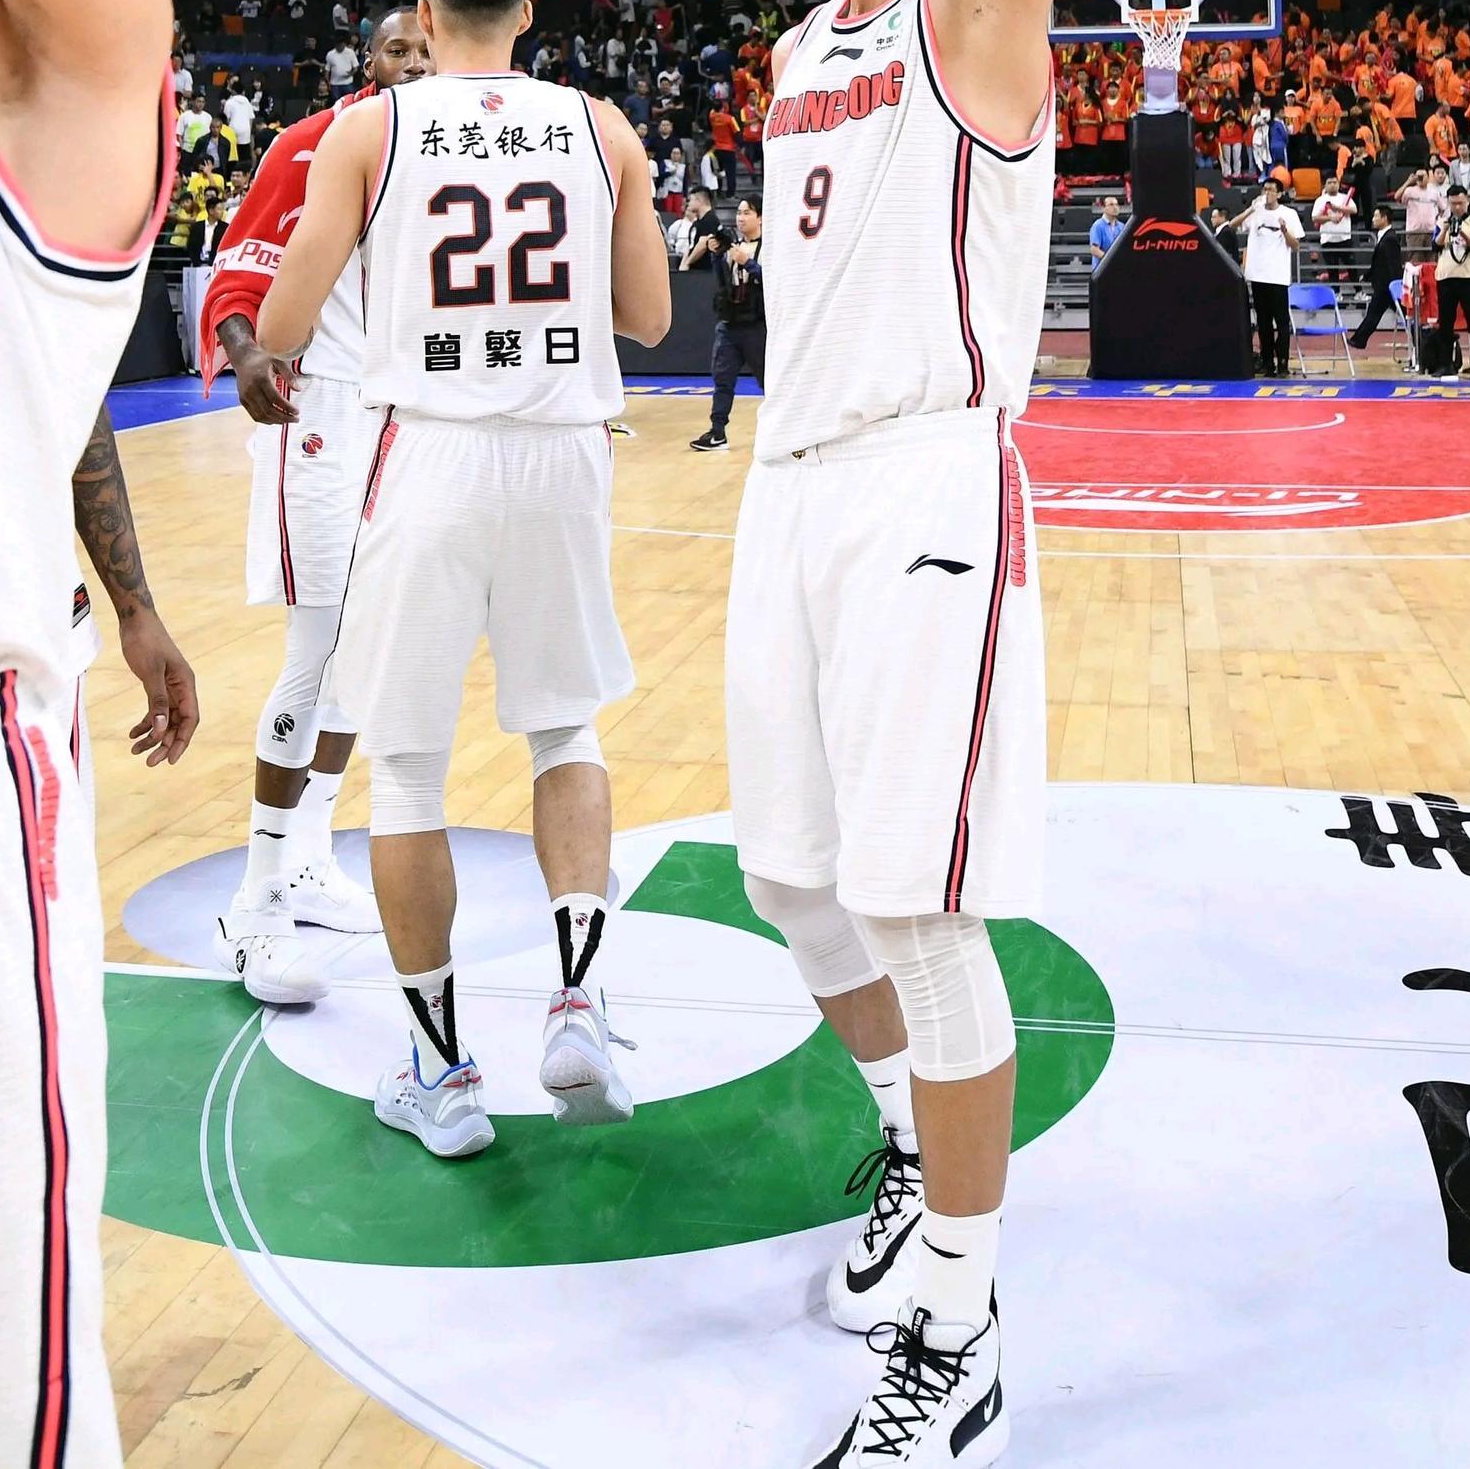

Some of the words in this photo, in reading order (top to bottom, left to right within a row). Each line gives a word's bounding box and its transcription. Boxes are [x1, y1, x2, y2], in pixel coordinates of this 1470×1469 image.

[420, 120, 574, 159] 东莞银行
[797, 164, 834, 241] 9
[427, 180, 572, 308] 22
[1133, 239, 1199, 251] LI-NING
